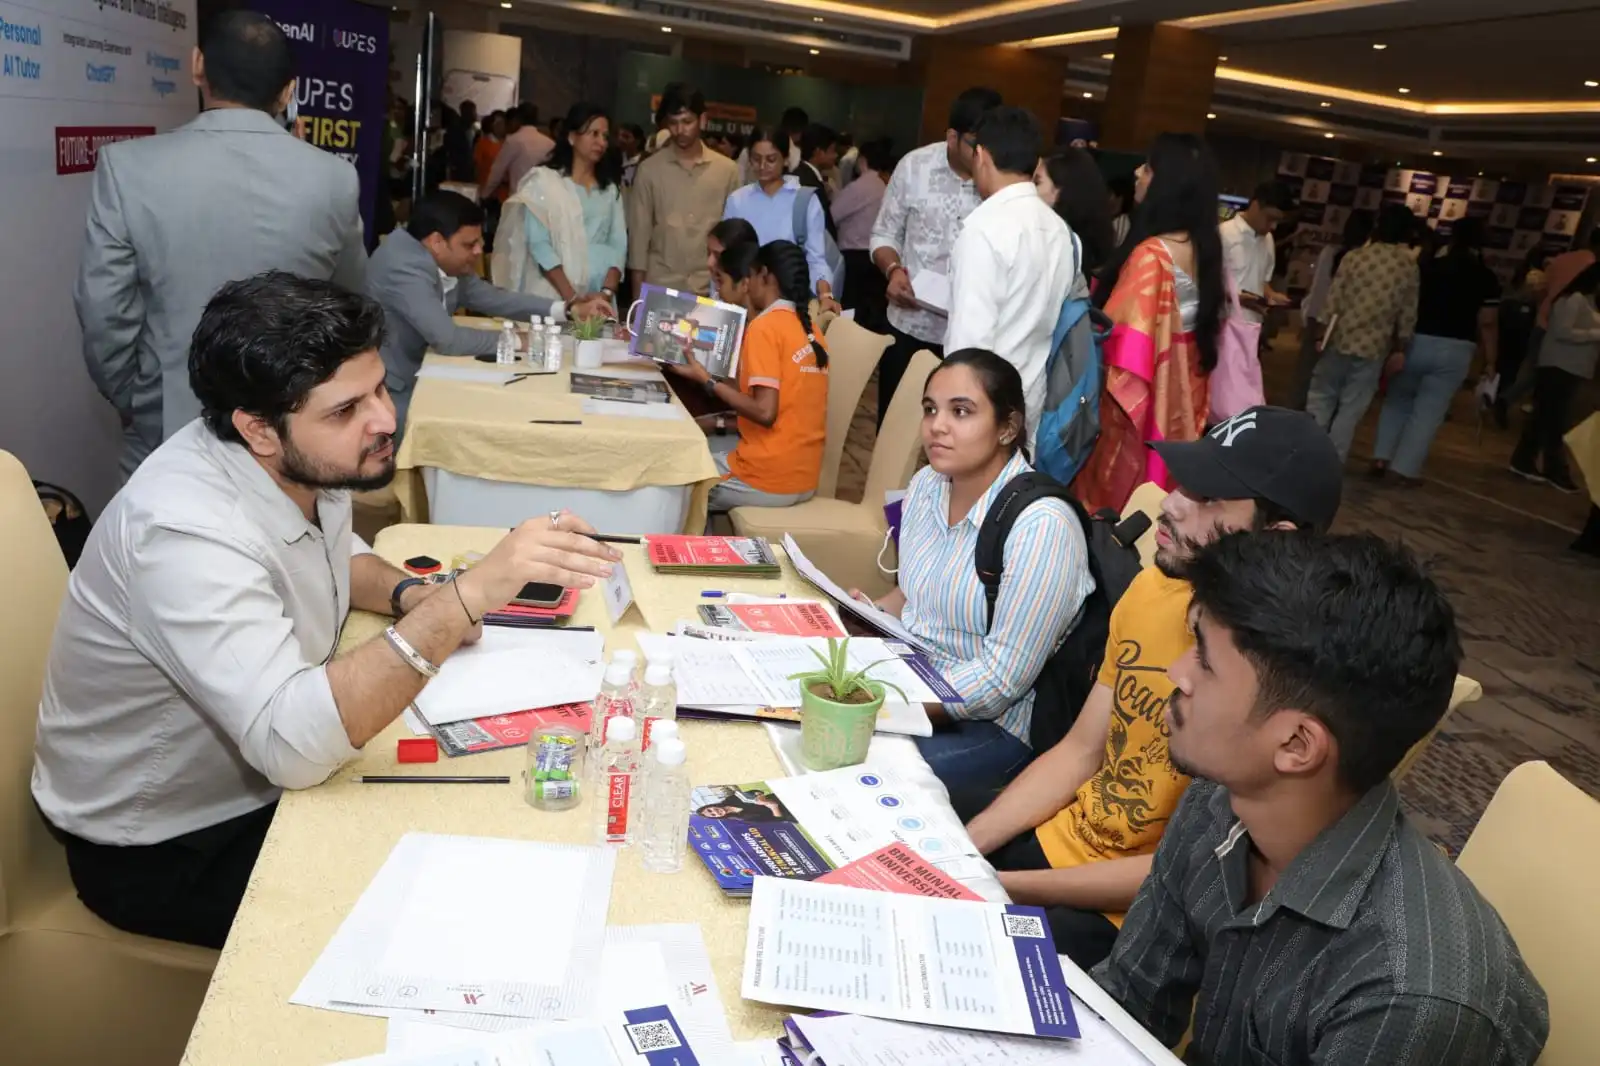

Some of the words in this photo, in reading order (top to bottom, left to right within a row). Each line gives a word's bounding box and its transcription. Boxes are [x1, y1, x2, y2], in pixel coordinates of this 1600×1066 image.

[0, 17, 41, 46] Personal
[3, 54, 13, 77] AI
[15, 56, 41, 80] Tutor
[295, 76, 353, 112] UPES
[299, 116, 361, 148] FIRST
[612, 776, 624, 809] CLEAR
[888, 847, 916, 868] BML
[913, 864, 963, 900] MUNJAL
